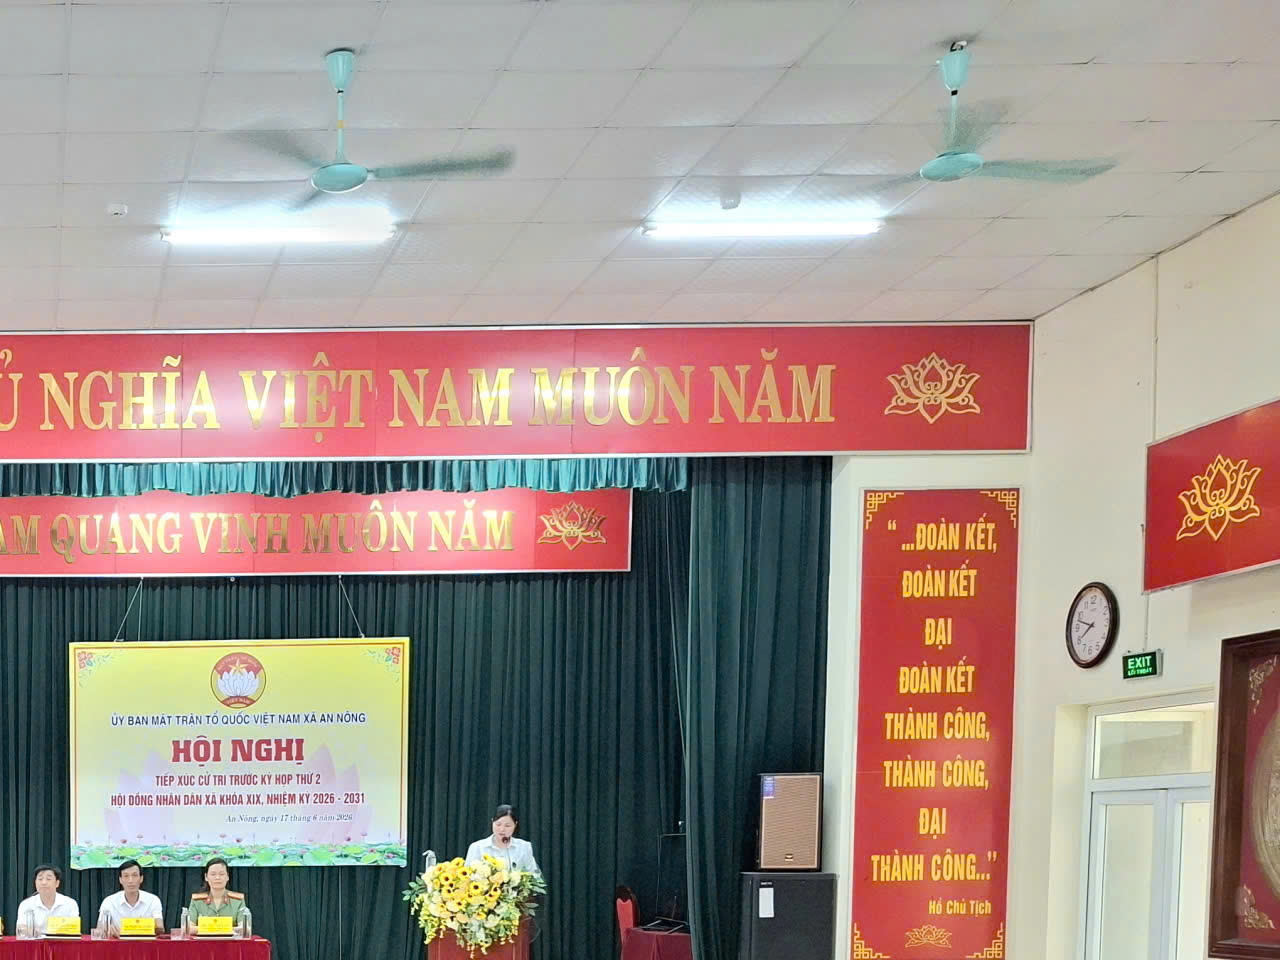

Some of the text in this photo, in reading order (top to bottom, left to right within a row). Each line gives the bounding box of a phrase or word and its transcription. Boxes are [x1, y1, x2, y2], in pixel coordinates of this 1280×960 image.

[39, 355, 220, 431] NGHĨA
[239, 352, 372, 442] VIỆT
[388, 367, 514, 427] NAM
[528, 347, 695, 427] MUÔN
[709, 348, 836, 423] NĂM
[50, 511, 182, 563] QUANG
[190, 512, 292, 553] VINH
[301, 499, 418, 553] MUÔN
[427, 499, 515, 552] NĂM
[965, 513, 997, 553] KẾT,
[902, 559, 977, 598] ĐOÀN KẾT
[925, 617, 952, 650] ĐẠI
[899, 656, 975, 694] ĐOÀN KẾT
[1128, 656, 1152, 669] EXIT
[111, 712, 125, 726] ỦY
[128, 716, 148, 726] BAN
[176, 713, 202, 727] TRẬN
[206, 710, 219, 725] TỔ
[221, 710, 250, 725] QUỐC
[253, 712, 275, 727] VIỆT
[278, 714, 300, 724] NAM
[304, 712, 317, 723] XÃ
[320, 713, 333, 723] AN
[336, 710, 366, 723] NÔNG
[884, 706, 990, 741] THÀNH CÔNG,
[172, 735, 304, 767] HỘI NGHỊ
[156, 772, 175, 786] TIẾP
[177, 773, 195, 786] XÚC
[198, 771, 211, 786] CỬ
[213, 775, 226, 786] TRI
[230, 772, 258, 786] TRƯỚC
[296, 771, 314, 785] THỨ
[315, 773, 321, 785] 2
[883, 754, 989, 790] THÀNH CÔNG,
[111, 792, 126, 808] HỘI
[128, 792, 153, 806] ĐỒNG
[156, 793, 181, 806] NHÂN
[183, 793, 202, 806] DÂN
[205, 792, 217, 805] XÃ
[219, 792, 243, 805] KHÓA
[246, 794, 264, 806] XIX,
[266, 791, 296, 807] NHIỆM
[299, 790, 310, 804] KỲ
[313, 793, 334, 804] 2026
[344, 793, 365, 804] 2031
[919, 808, 946, 839] ĐẠI
[871, 850, 924, 881] THÀNH
[929, 897, 992, 917] Hồ Chủ Tịch
